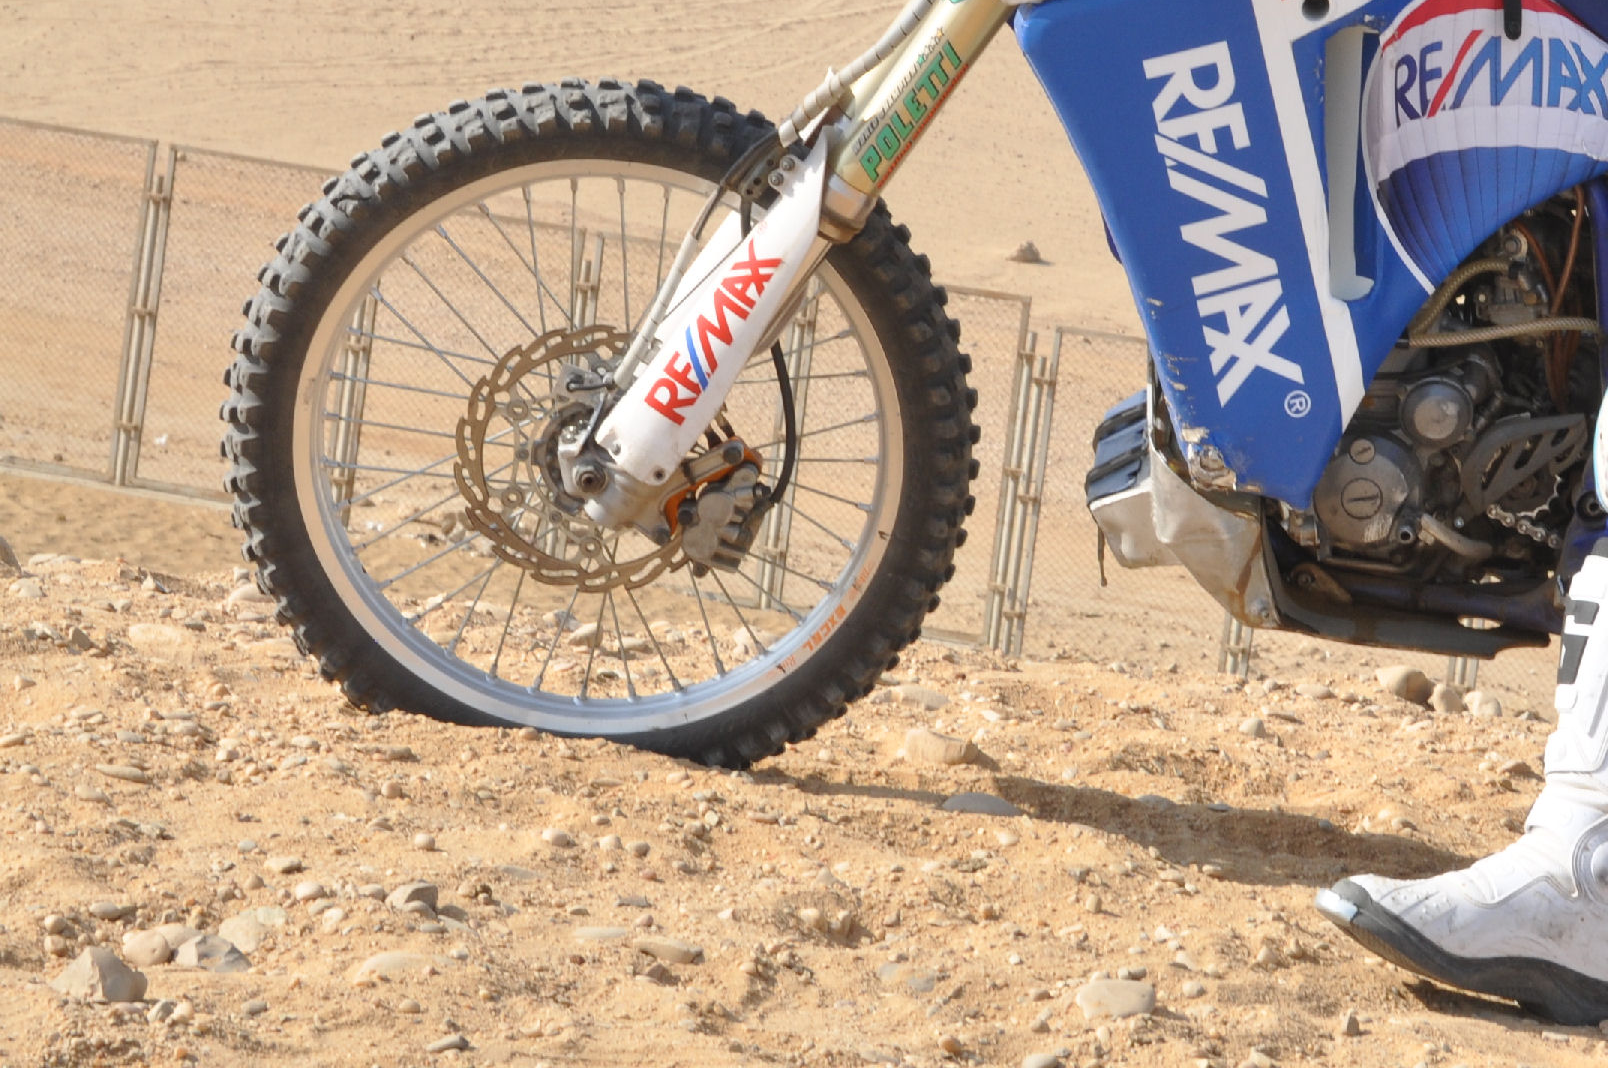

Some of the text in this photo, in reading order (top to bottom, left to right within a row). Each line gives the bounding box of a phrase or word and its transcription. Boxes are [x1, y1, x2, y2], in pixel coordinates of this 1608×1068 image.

[859, 40, 962, 183] POLETTI
[1142, 39, 1305, 409] RE/MAX
[644, 237, 784, 427] RE/MAX
